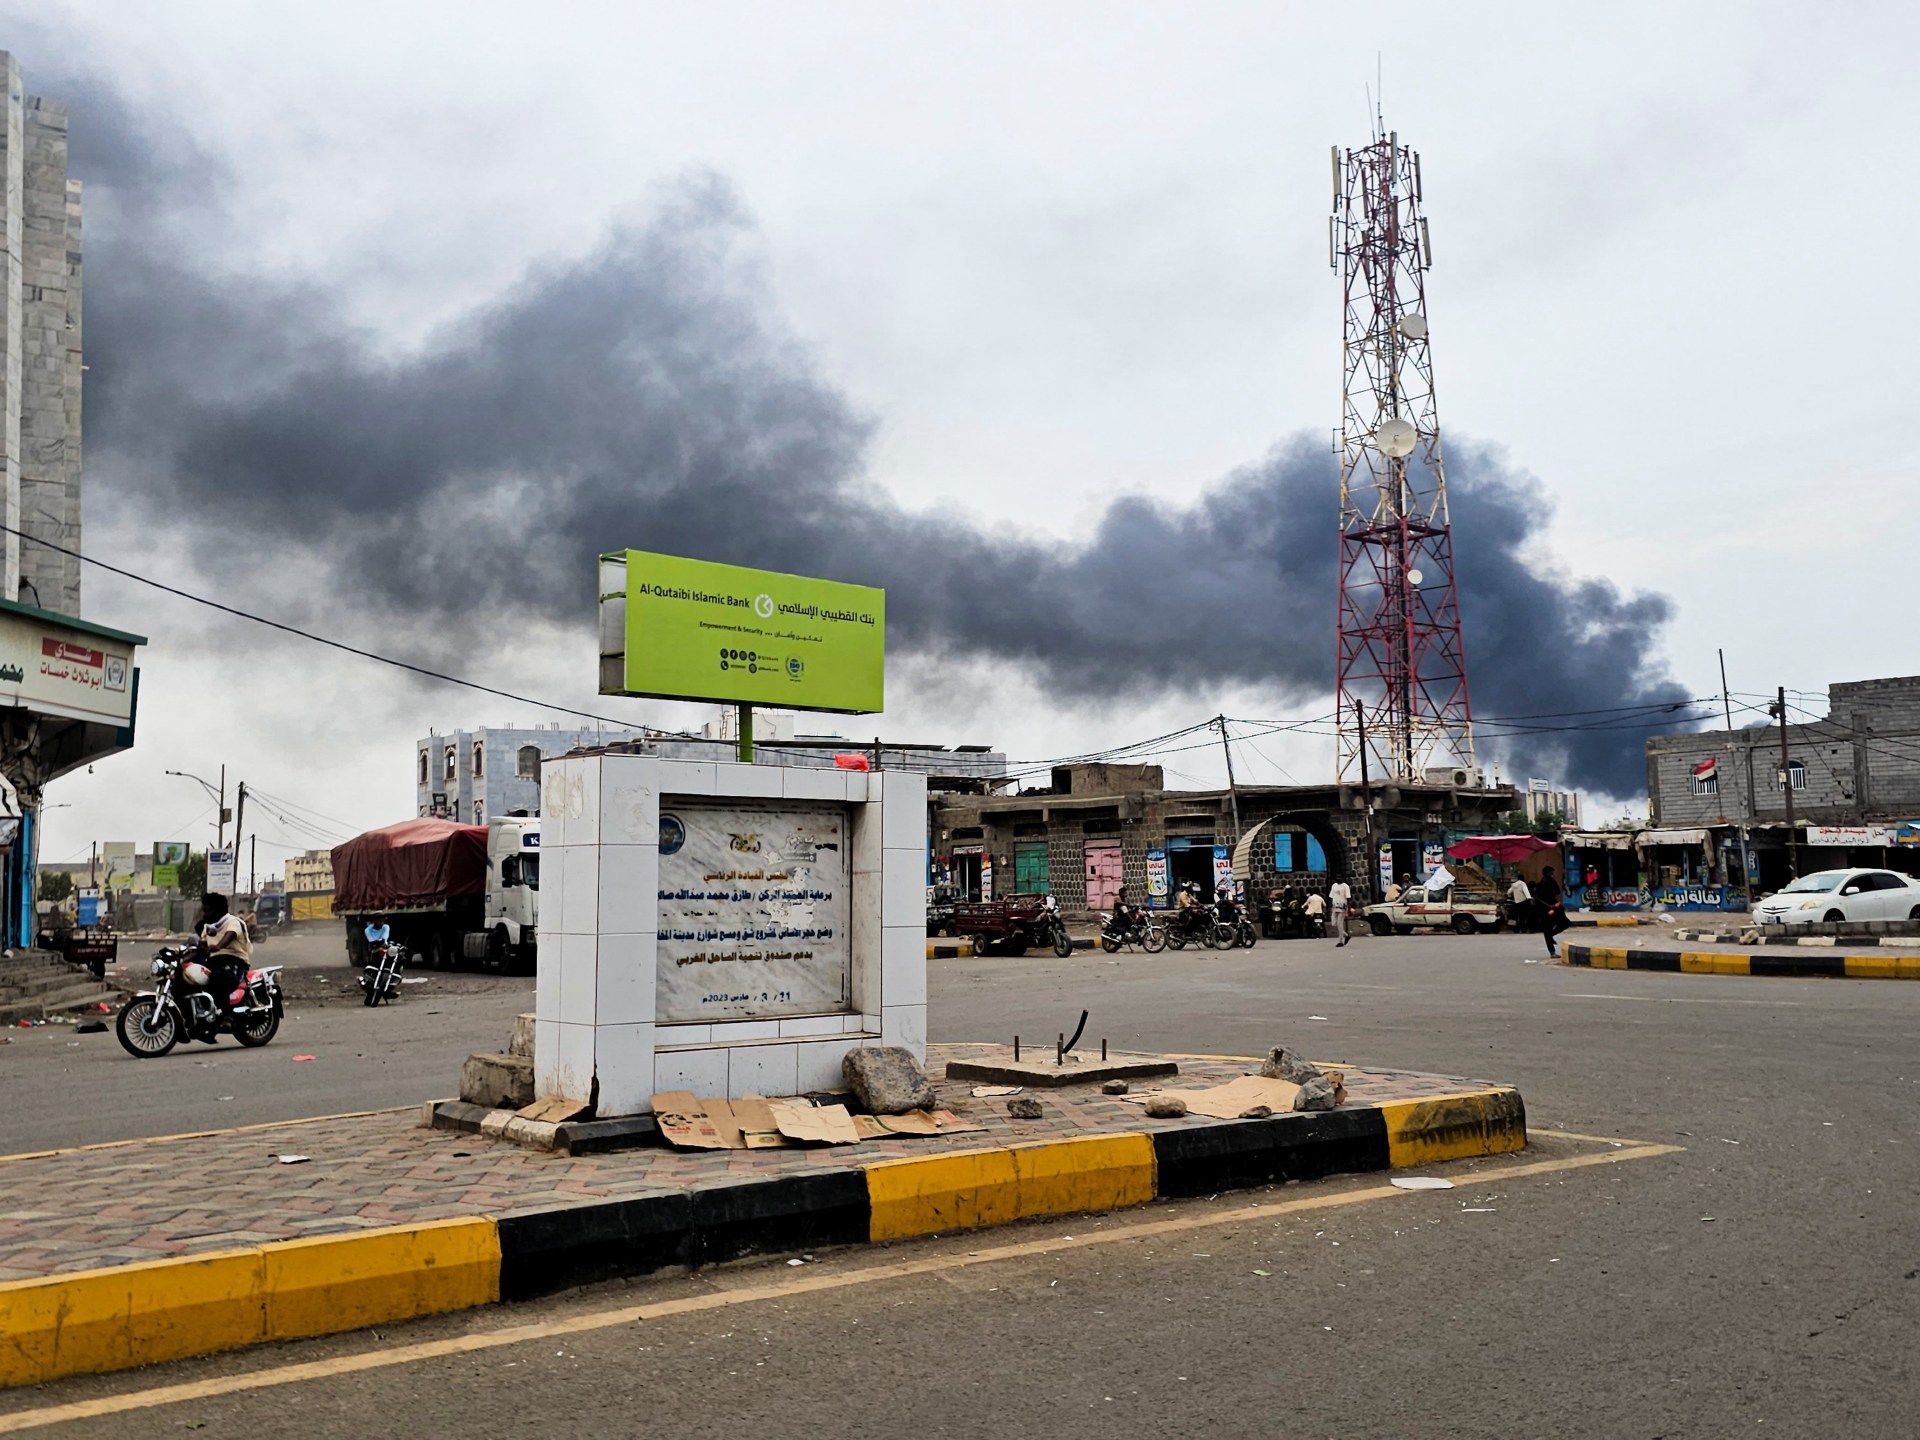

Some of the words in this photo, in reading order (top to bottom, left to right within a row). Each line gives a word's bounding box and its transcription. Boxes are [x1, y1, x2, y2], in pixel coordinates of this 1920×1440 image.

[640, 584, 691, 600] Al-Qutaibi
[692, 591, 725, 605] Islamic
[727, 595, 750, 608] Bank
[778, 603, 818, 619] الإسلامي
[820, 609, 858, 622] القطيبي
[860, 613, 875, 627] بنك
[699, 621, 737, 631] Empowerment
[742, 626, 763, 636] Security
[706, 890, 730, 901] محمد
[731, 889, 752, 902] طارق
[1688, 889, 1721, 909] بقالة
[673, 928, 695, 942] مدينة
[696, 928, 719, 942] شوارع
[817, 926, 833, 939] وضع
[676, 952, 706, 968] الغربي
[707, 951, 737, 965] الساحل
[738, 950, 763, 964] تنمية
[764, 950, 793, 963] صندوق
[793, 950, 813, 962] بدعم
[730, 992, 750, 1002] مارس
